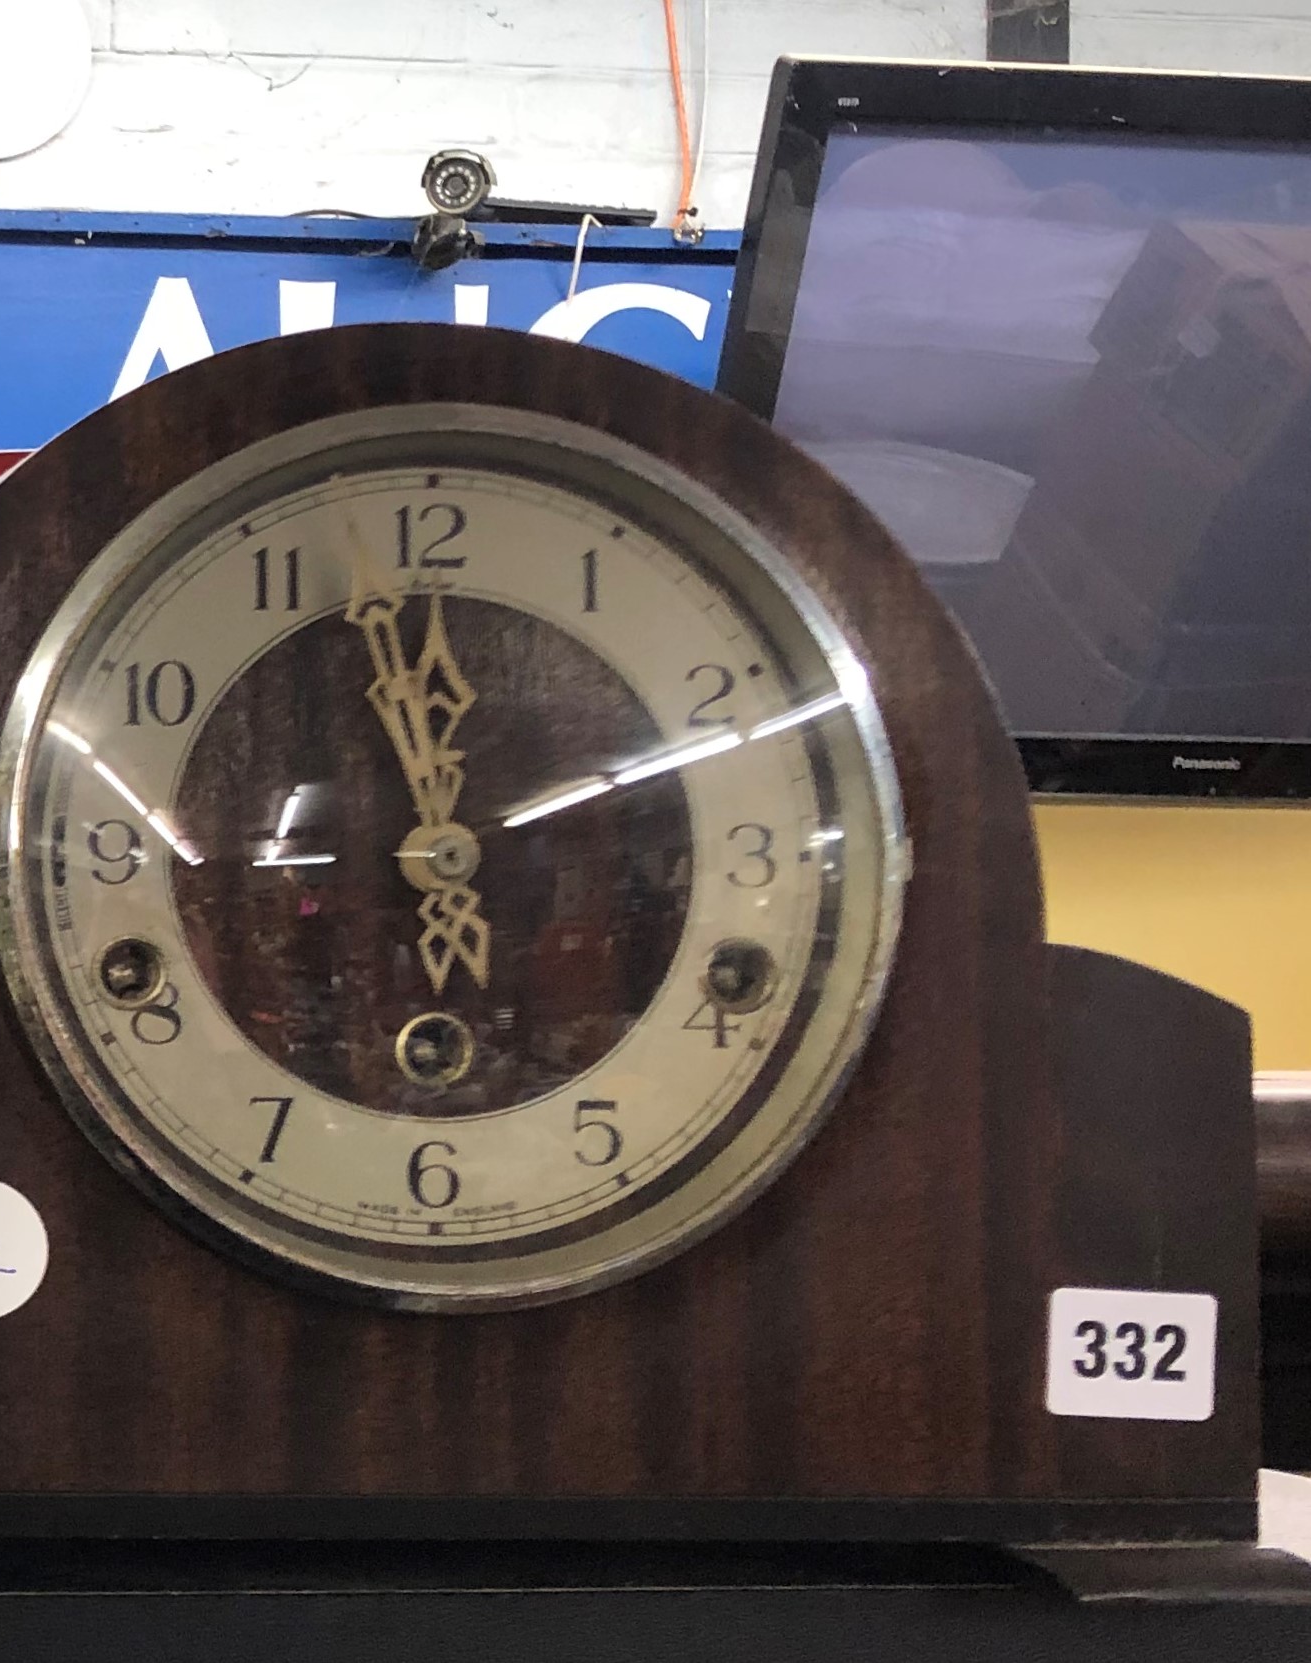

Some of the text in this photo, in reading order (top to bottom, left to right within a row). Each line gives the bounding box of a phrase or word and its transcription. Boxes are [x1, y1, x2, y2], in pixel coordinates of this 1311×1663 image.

[395, 503, 468, 569] 12
[253, 547, 302, 611] 11
[579, 548, 599, 613] 1
[124, 660, 195, 726] 10
[685, 664, 736, 728] 2
[1172, 756, 1241, 770] Panasonic
[88, 819, 141, 885] 9
[727, 823, 776, 888] 3
[131, 982, 181, 1044] 8
[681, 1000, 741, 1048] 4
[249, 1096, 294, 1163] 7
[573, 1100, 622, 1166] 5
[407, 1141, 460, 1208] 6
[1074, 1320, 1187, 1382] 332
